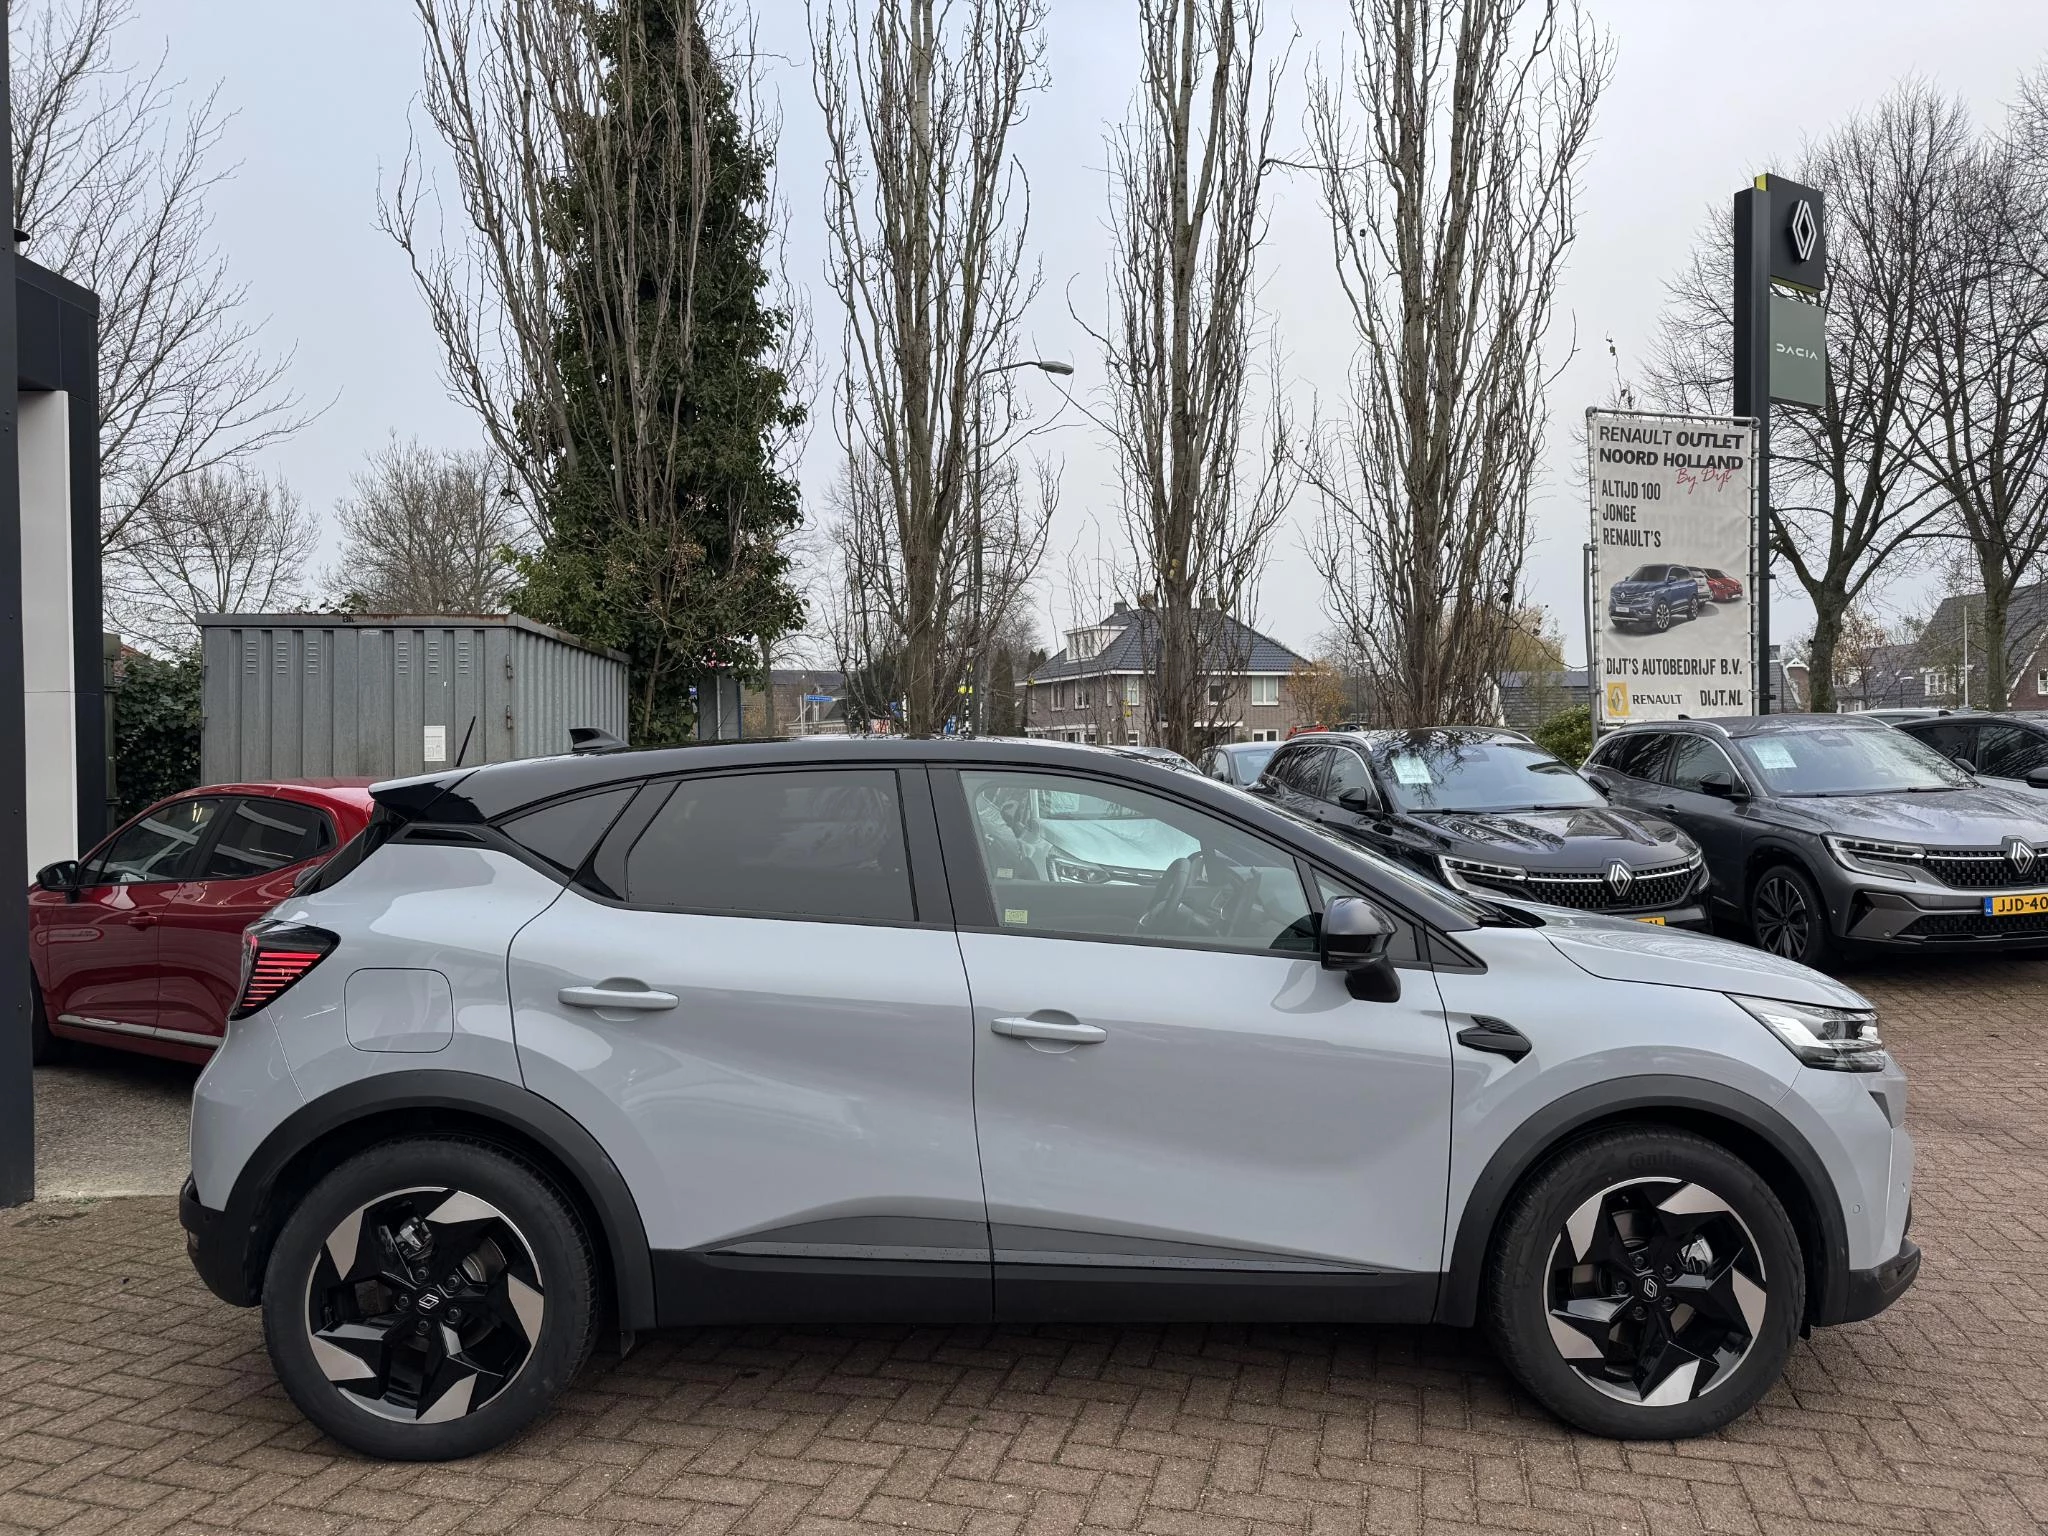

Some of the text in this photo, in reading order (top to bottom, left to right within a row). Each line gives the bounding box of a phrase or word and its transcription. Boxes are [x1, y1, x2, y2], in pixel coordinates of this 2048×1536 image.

[1776, 343, 1818, 360] DACIA
[1600, 425, 1745, 450] RENAULT OUTLET
[1600, 447, 1744, 470] NOORD HOLLAND
[1602, 479, 1661, 501] ALTIJD 100
[1675, 467, 1697, 495] By
[1603, 503, 1637, 523] JONGE
[1603, 527, 1662, 548] RENAULT'S
[1606, 657, 1743, 676] DIJT'S AUTOBEDRIJF B.V.
[1632, 694, 1683, 705] RENAULT
[1700, 689, 1744, 707] DIJT.NL
